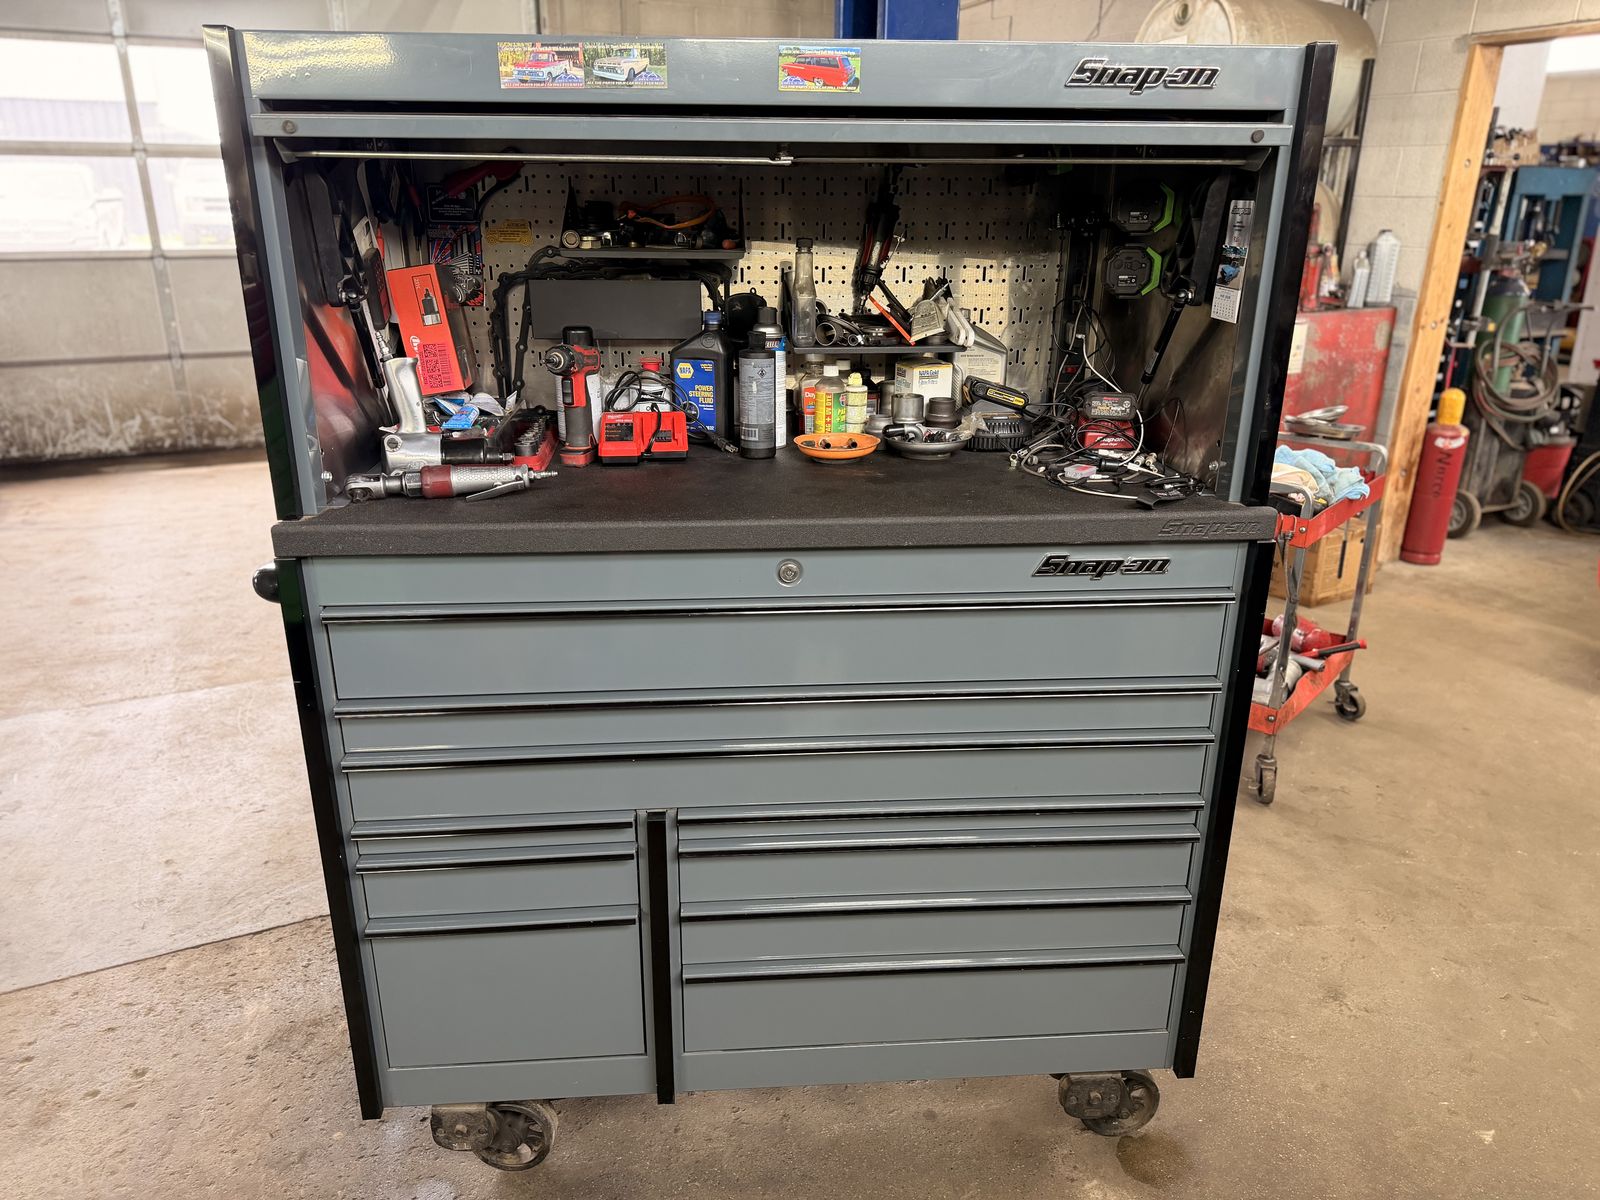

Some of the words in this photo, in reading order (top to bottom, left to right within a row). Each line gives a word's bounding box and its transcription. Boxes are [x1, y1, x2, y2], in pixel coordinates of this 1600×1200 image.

[1064, 57, 1220, 95] Snap-on
[1158, 518, 1260, 538] Snap-on
[1032, 552, 1172, 580] Snap-on
